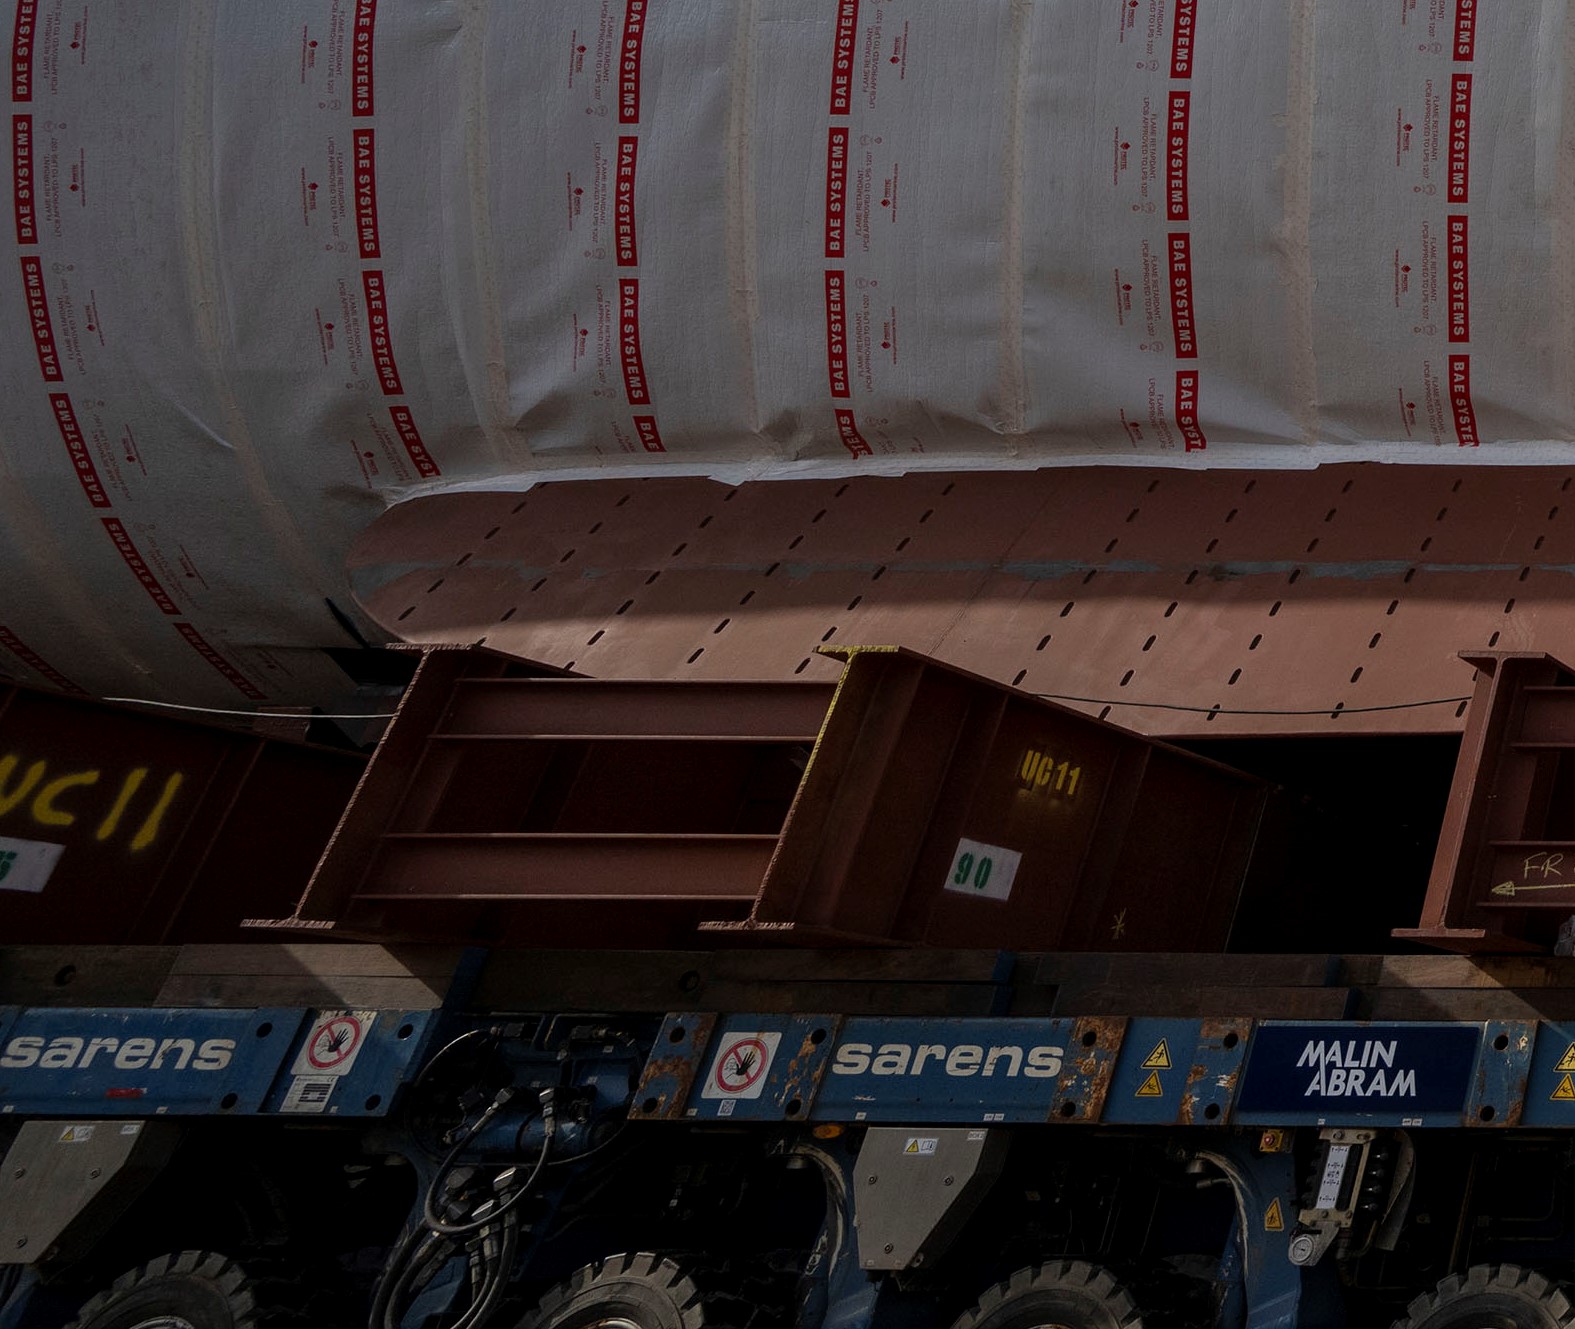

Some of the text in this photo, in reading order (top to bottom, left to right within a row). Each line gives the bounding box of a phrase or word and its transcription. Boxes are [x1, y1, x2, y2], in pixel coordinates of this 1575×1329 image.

[16, 61, 29, 95] BAE
[357, 32, 370, 111] SYSTEMS
[623, 1, 644, 118] BAE SYSTEMS
[834, 74, 849, 108] BAE
[1171, 97, 1186, 215] BAE SYSTEMS
[1452, 80, 1468, 198] BAE SYSTEMS
[17, 120, 33, 238] BAE SYSTEMS
[358, 135, 376, 253] BAE SYSTEMS
[619, 143, 634, 261] BAE SYSTEMS
[829, 133, 845, 252] BAE SYSTEMS
[25, 262, 58, 375] BAE SYSTEMS
[1172, 239, 1194, 353] BAE SYSTEMS
[1452, 221, 1466, 337] BAE SYSTEMS
[367, 277, 399, 390] BAE SYSTEMS
[623, 285, 646, 400] BAE SYSTEMS
[829, 275, 846, 391] BAE SYSTEMS
[1180, 377, 1194, 411] BAE
[1453, 361, 1466, 394] BAE
[395, 412, 417, 441] BAE
[640, 422, 660, 450] BAE
[1020, 749, 1081, 797] UC11
[954, 852, 993, 889] 90
[1523, 851, 1563, 880] FR
[0, 1035, 237, 1071] sarens
[831, 1042, 1065, 1078] sarens
[1296, 1040, 1398, 1069] MALIN
[1304, 1069, 1417, 1098] ABRAM
